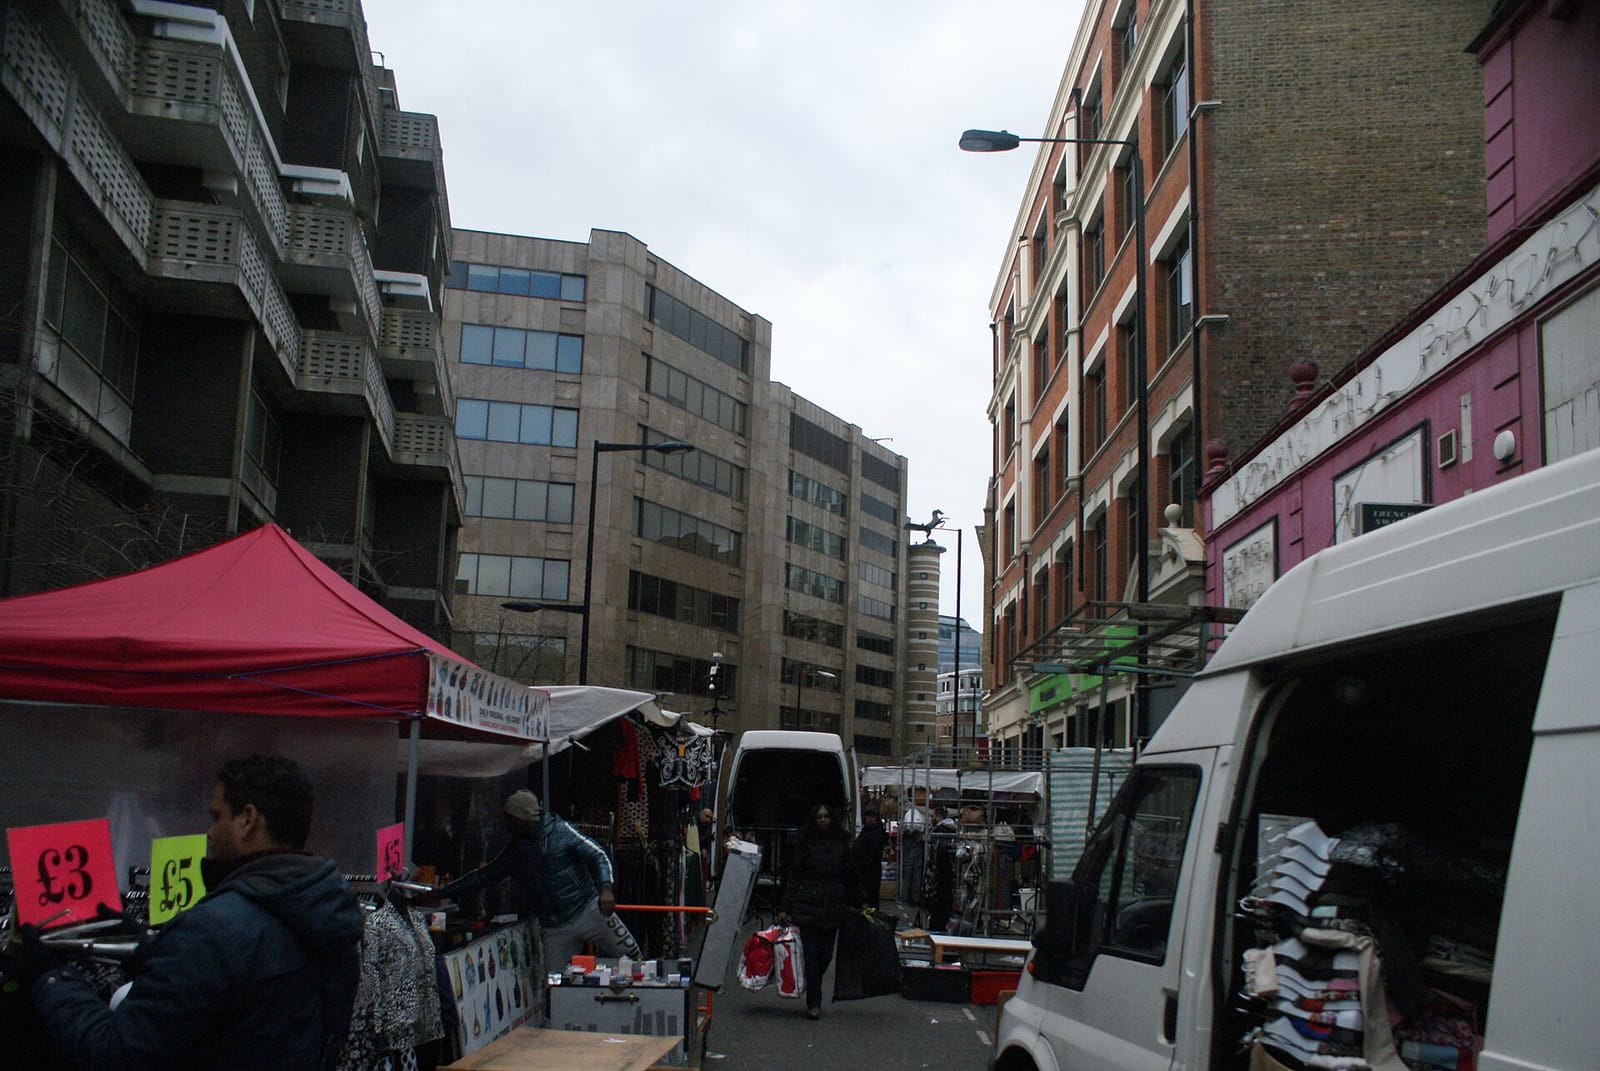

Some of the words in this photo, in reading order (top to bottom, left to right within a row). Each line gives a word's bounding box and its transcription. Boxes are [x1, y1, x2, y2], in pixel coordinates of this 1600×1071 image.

[36, 844, 93, 906] £3
[384, 838, 400, 873] £5
[160, 856, 193, 913] £5
